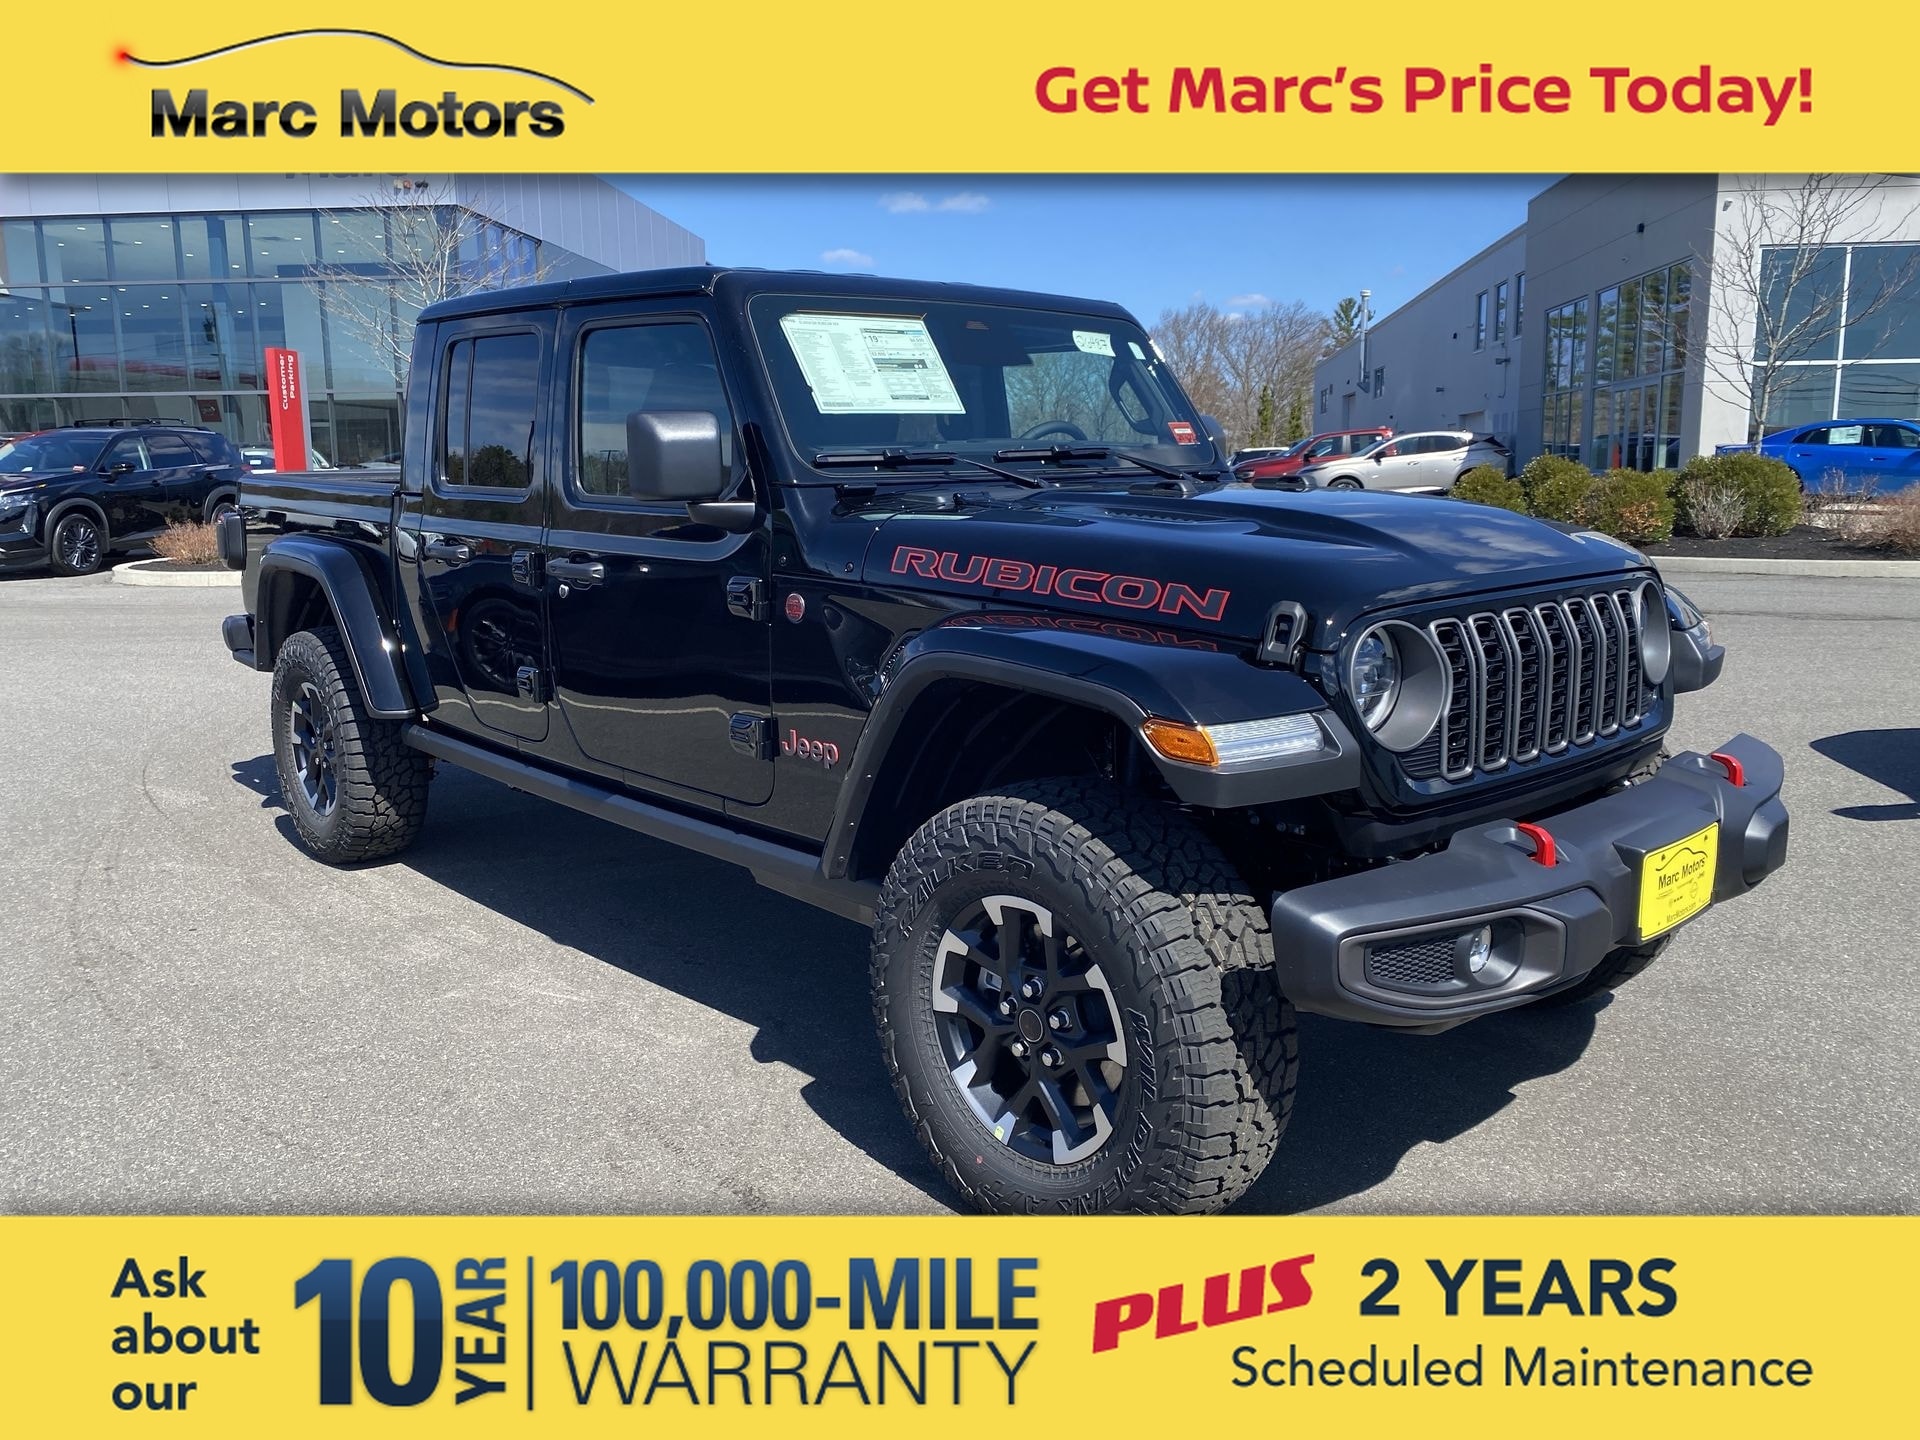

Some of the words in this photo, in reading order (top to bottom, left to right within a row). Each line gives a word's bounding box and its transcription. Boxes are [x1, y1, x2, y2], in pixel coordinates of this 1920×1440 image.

[280, 353, 288, 410] Customer
[891, 546, 1231, 621] RUBICON
[782, 729, 839, 769] Jeep
[1658, 870, 1679, 891] Marc
[1682, 857, 1705, 879] Motors
